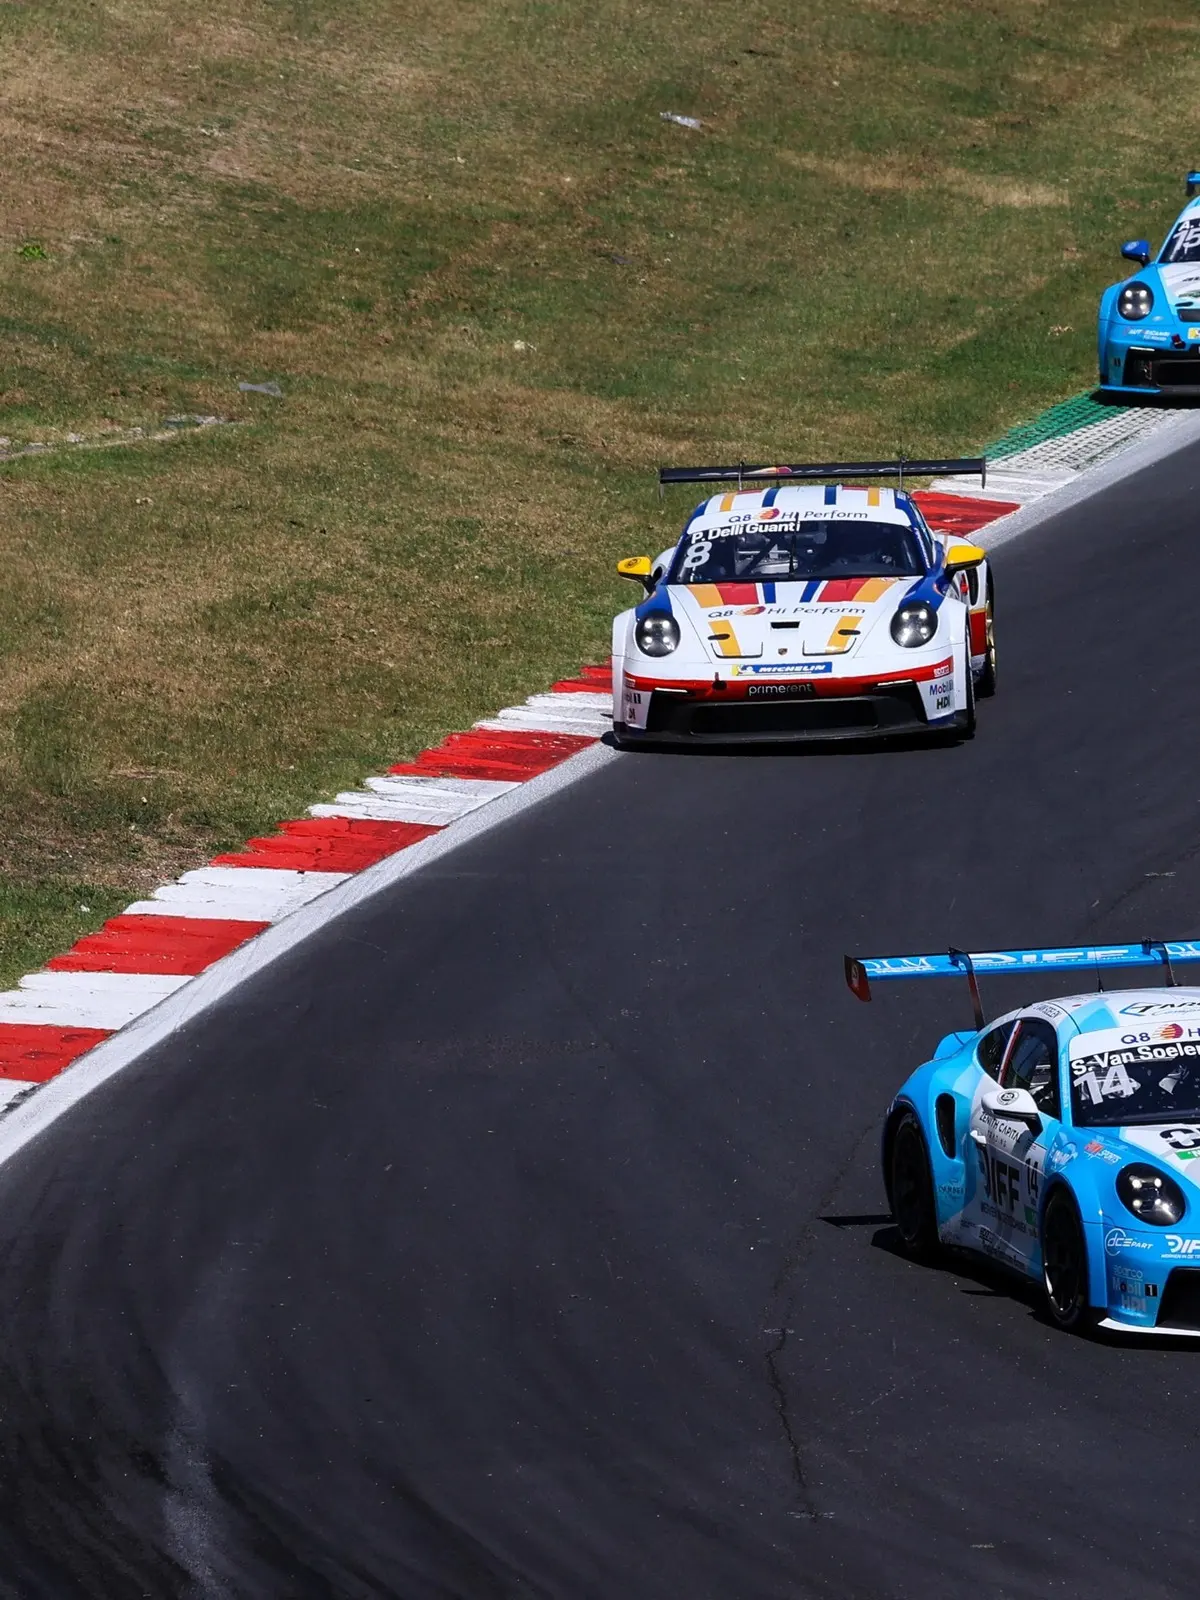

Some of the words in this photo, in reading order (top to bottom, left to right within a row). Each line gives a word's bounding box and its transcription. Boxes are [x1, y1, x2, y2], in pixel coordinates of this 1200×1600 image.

[1178, 221, 1194, 231] A.
[728, 514, 752, 523] Q8
[782, 511, 799, 520] H
[804, 509, 868, 519] Perform
[691, 531, 706, 544] P.
[708, 524, 744, 541] Delli
[745, 521, 801, 534] Guanti
[684, 541, 713, 569] 8
[708, 609, 734, 618] Q8
[767, 607, 786, 615] Hi
[793, 606, 866, 615] Perform
[758, 664, 826, 673] MICHELIN
[749, 683, 813, 697] primerent
[968, 949, 1129, 964] DIFF
[1121, 1032, 1151, 1044] Q8
[1071, 1058, 1094, 1076] S.
[1093, 1050, 1136, 1070] Van
[1072, 1063, 1136, 1105] 14
